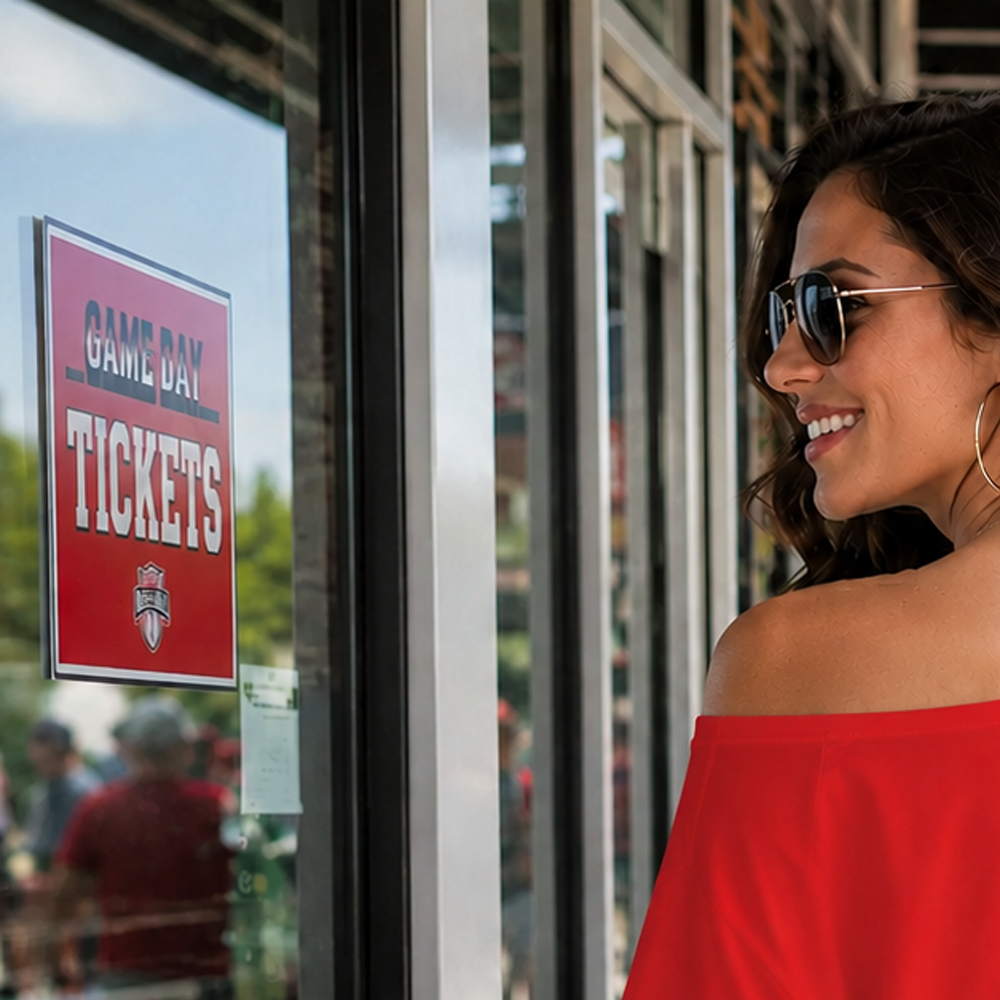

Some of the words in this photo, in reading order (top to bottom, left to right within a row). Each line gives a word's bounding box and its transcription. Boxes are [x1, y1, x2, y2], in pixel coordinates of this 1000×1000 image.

[85, 299, 155, 387] GAME
[160, 326, 203, 402] DAY
[66, 407, 223, 555] TICKETS
